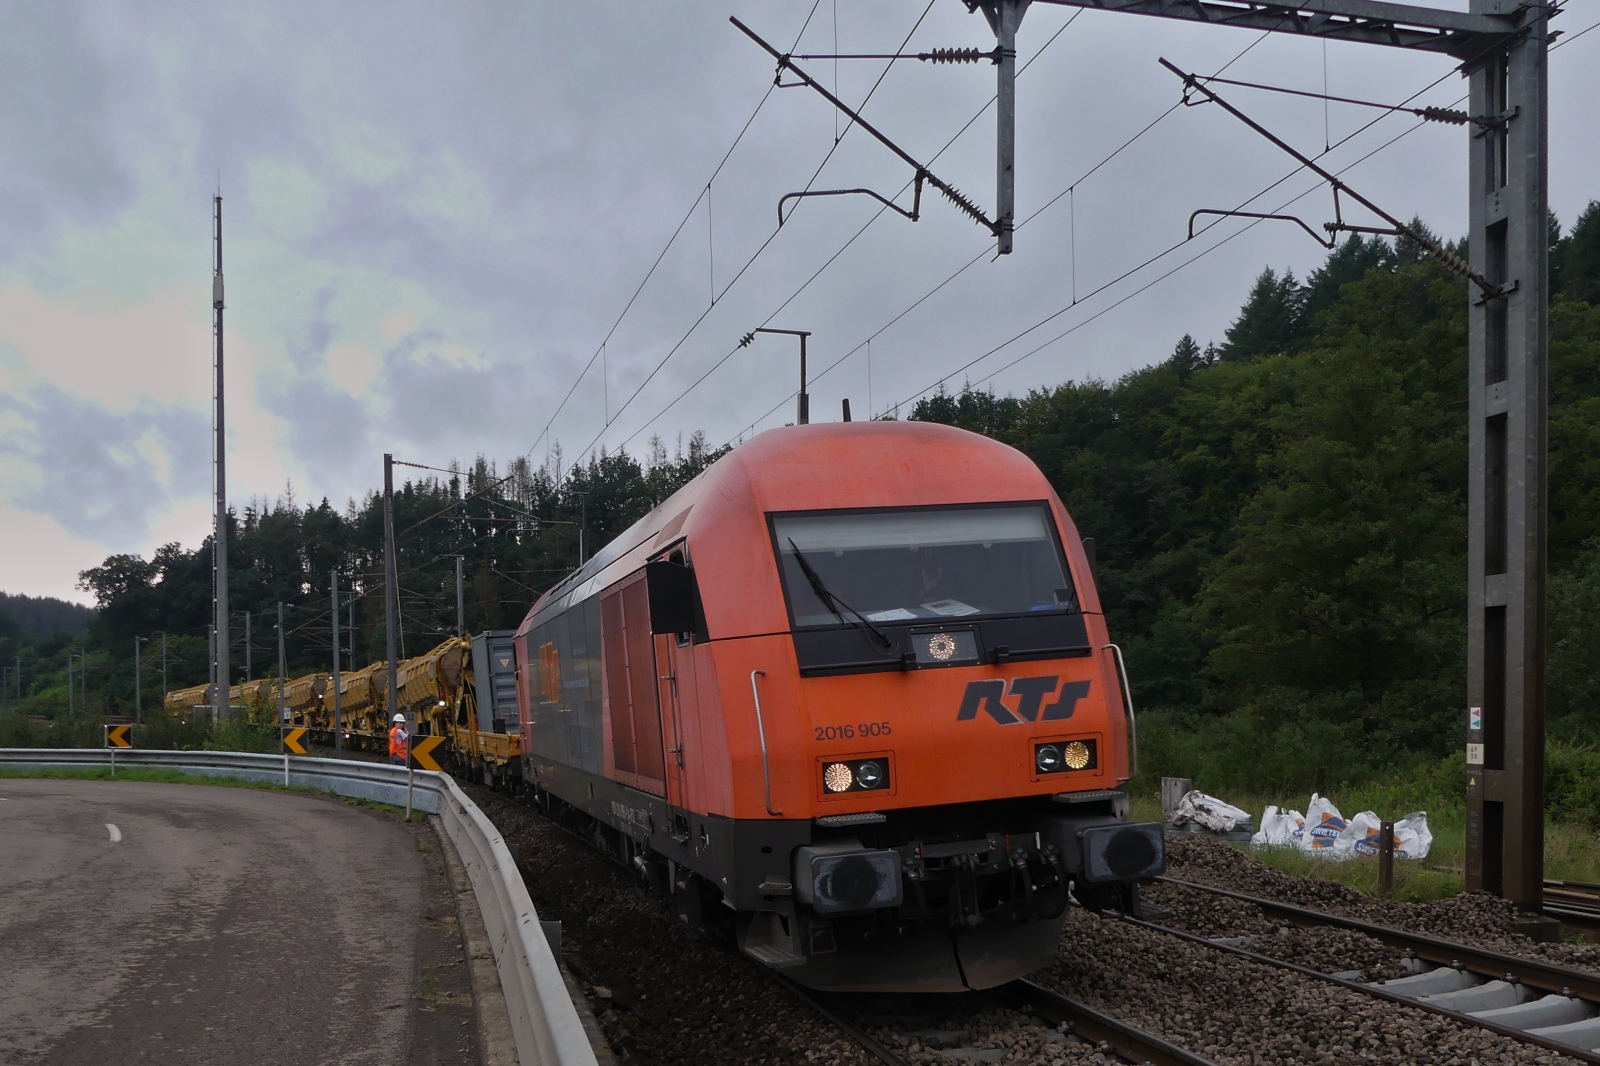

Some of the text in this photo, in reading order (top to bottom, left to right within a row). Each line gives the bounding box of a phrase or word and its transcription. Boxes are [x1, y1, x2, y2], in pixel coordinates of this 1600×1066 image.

[956, 675, 1091, 726] RTS
[815, 721, 892, 741] 2016 905
